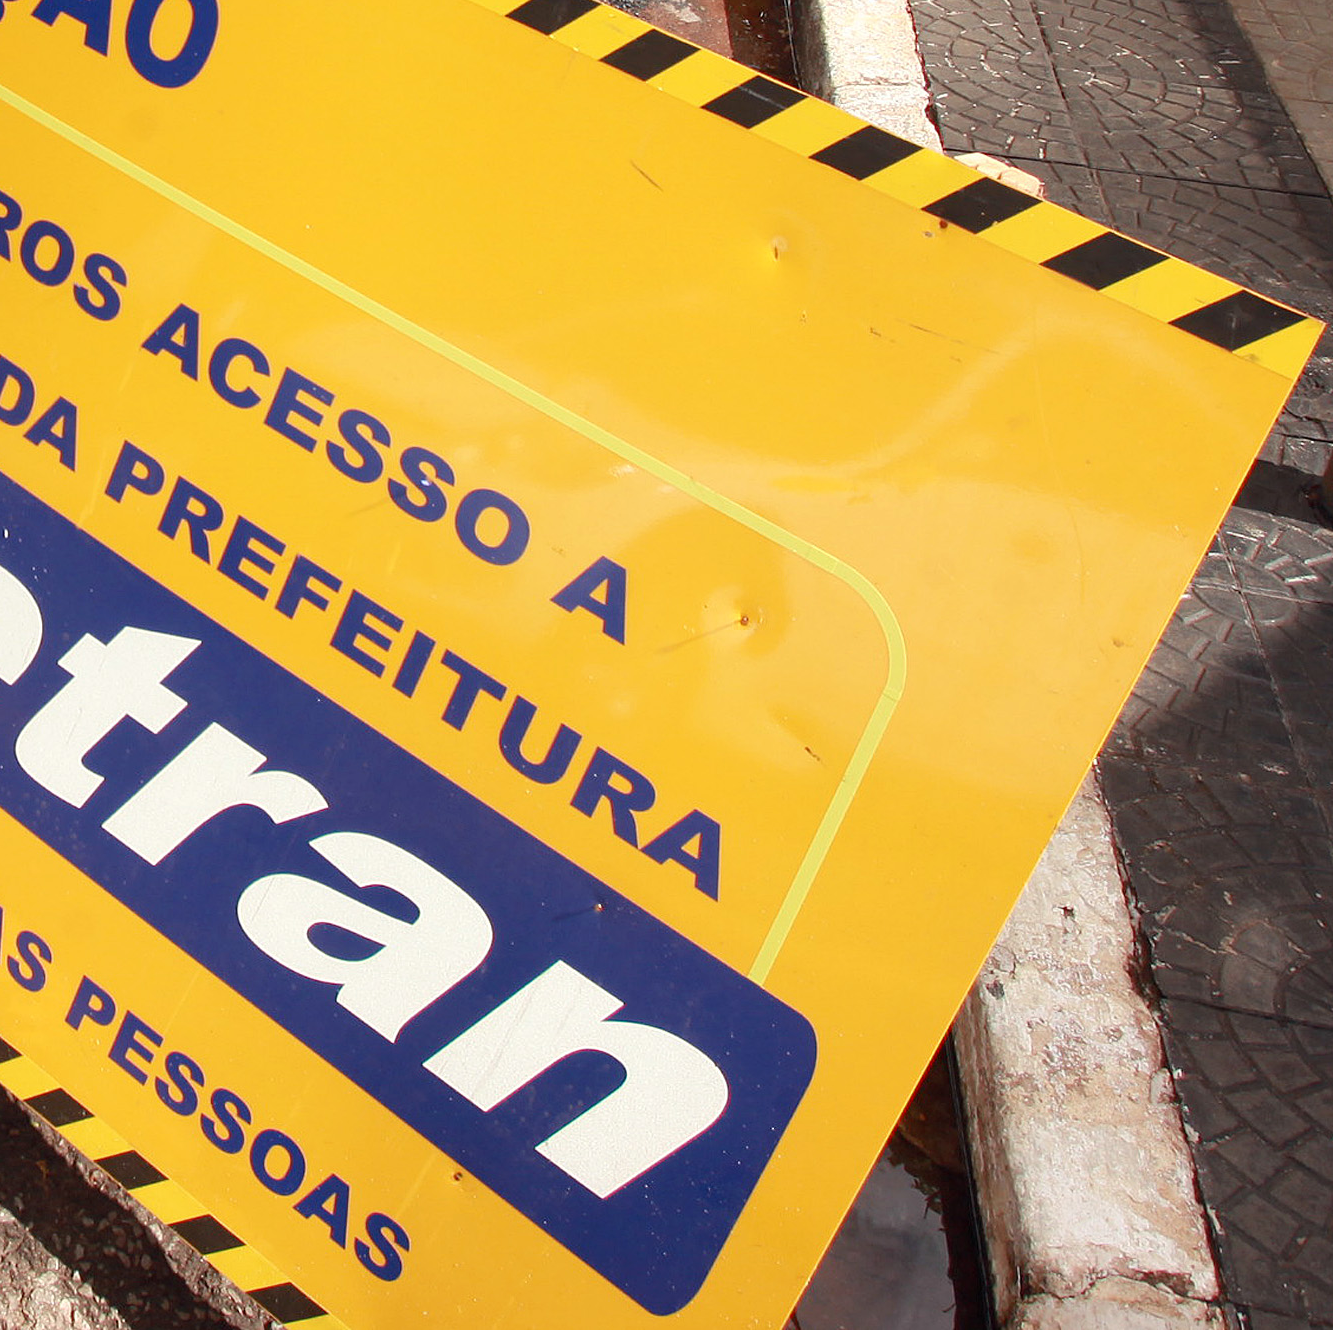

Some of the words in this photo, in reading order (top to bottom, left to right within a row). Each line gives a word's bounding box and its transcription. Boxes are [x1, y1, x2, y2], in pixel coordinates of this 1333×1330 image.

[140, 303, 532, 567] ACESSO
[551, 554, 629, 646] A
[104, 439, 722, 903] PREFEITURA
[64, 974, 411, 1282] PESSOAS
